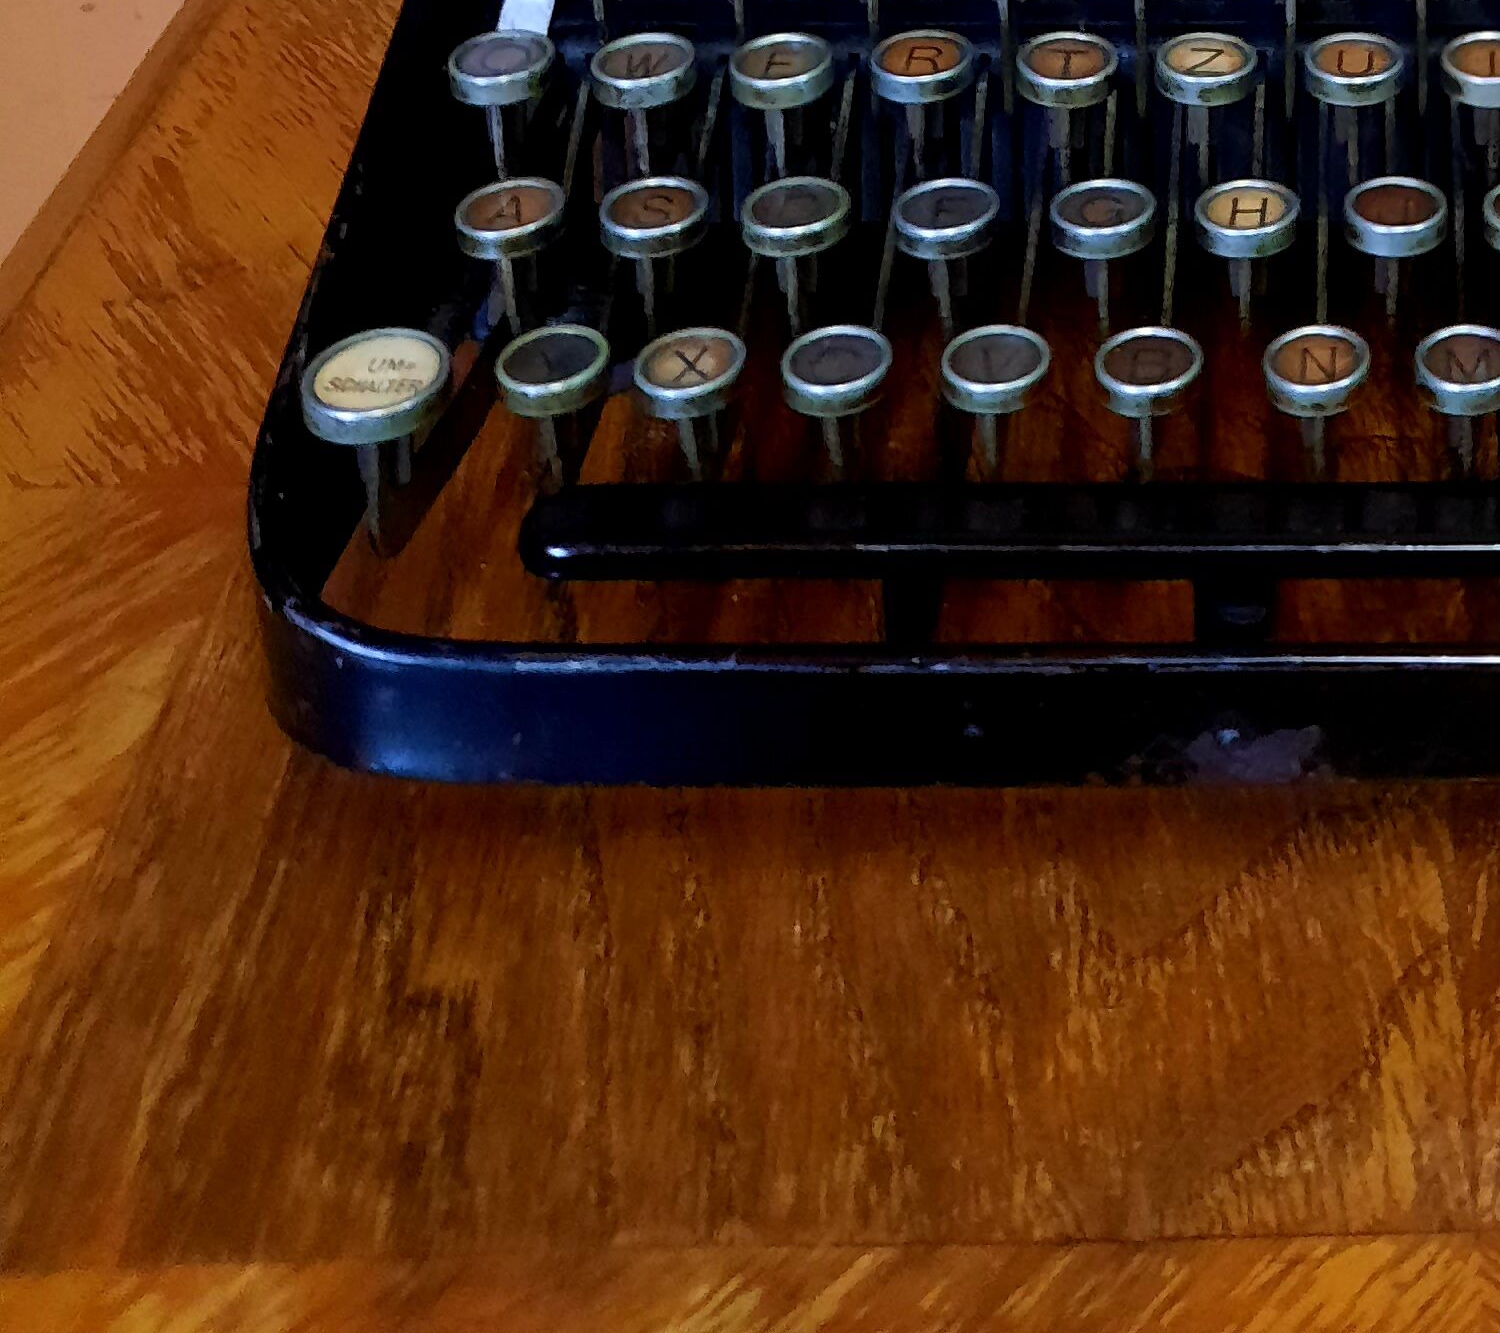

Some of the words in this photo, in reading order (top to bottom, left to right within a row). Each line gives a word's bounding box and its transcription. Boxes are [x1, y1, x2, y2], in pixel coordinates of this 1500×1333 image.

[905, 45, 944, 74] R
[1046, 47, 1090, 79] T
[1184, 46, 1228, 76] Z
[1336, 48, 1376, 77] U
[1228, 196, 1269, 228] H
[673, 344, 710, 384] X
[1300, 346, 1338, 383] N
